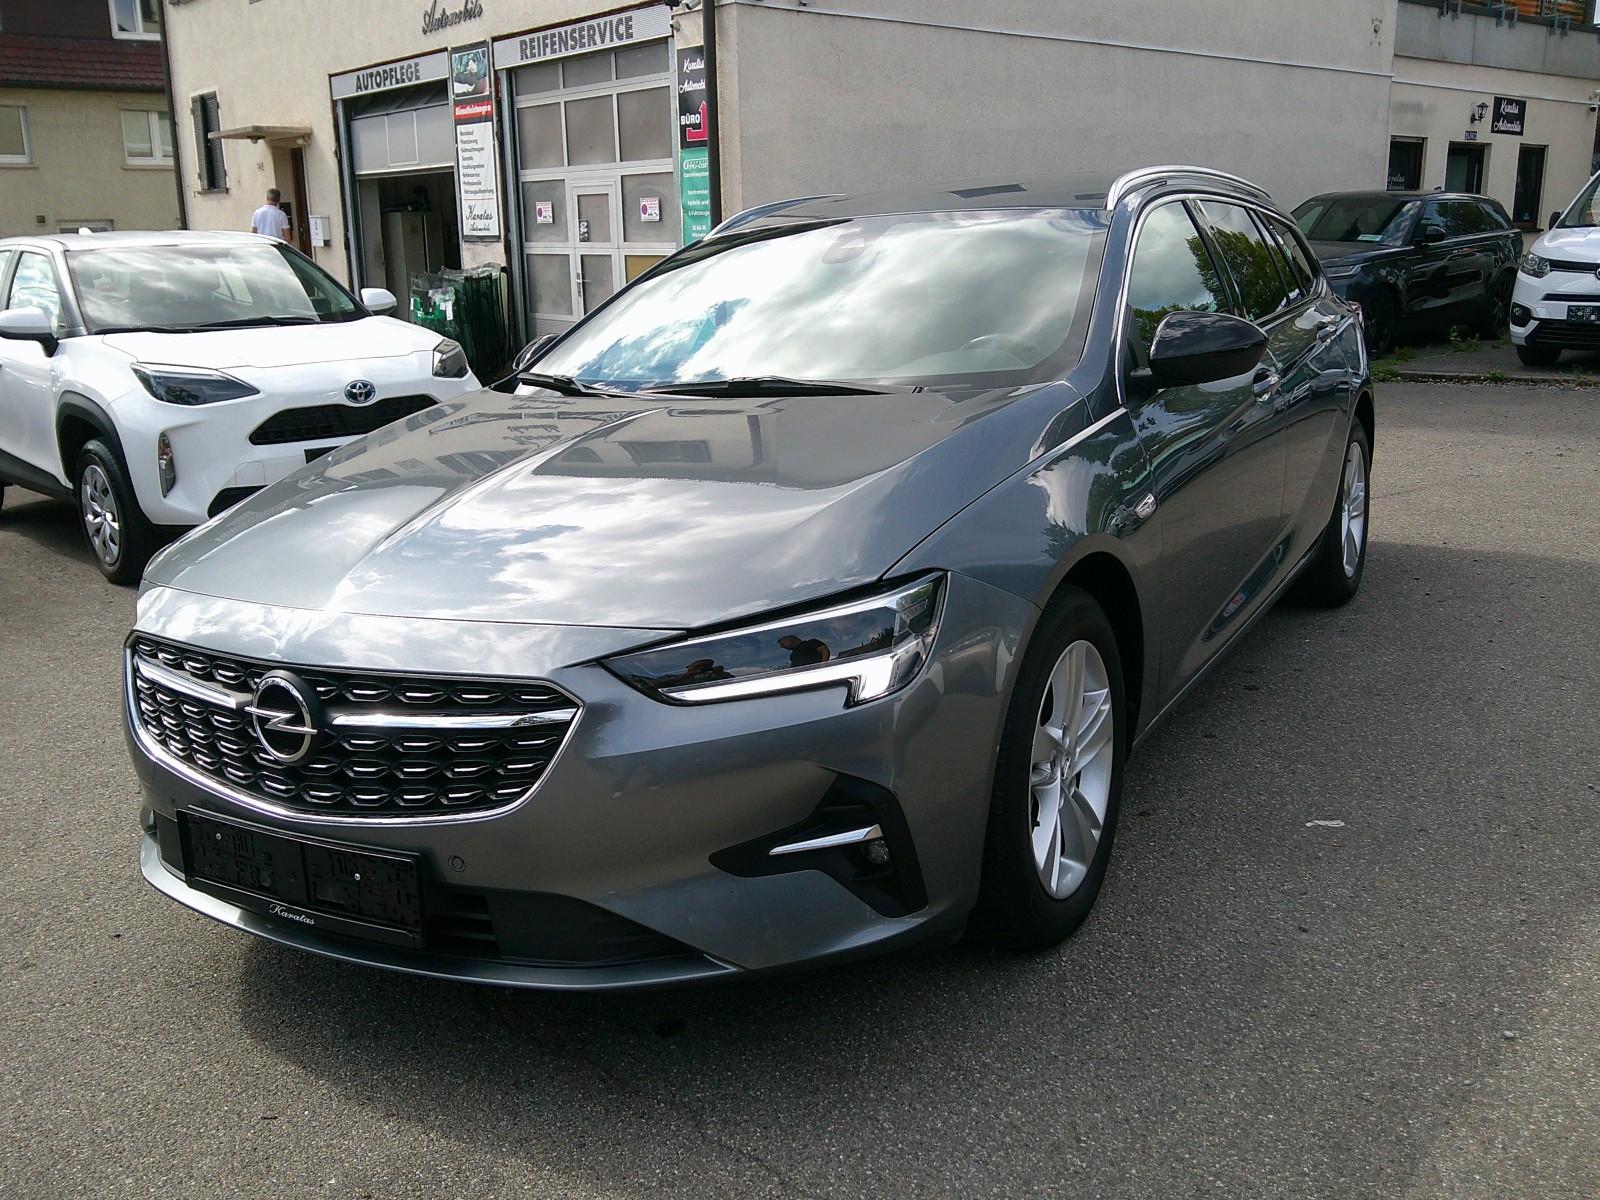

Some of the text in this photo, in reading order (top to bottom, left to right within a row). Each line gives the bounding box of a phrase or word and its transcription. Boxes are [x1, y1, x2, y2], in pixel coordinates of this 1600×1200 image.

[519, 15, 634, 61] REIFENSERVICE
[355, 61, 421, 92] AUTOPFLEGE
[681, 112, 700, 125] BÜRO
[270, 904, 315, 924] Karatas
